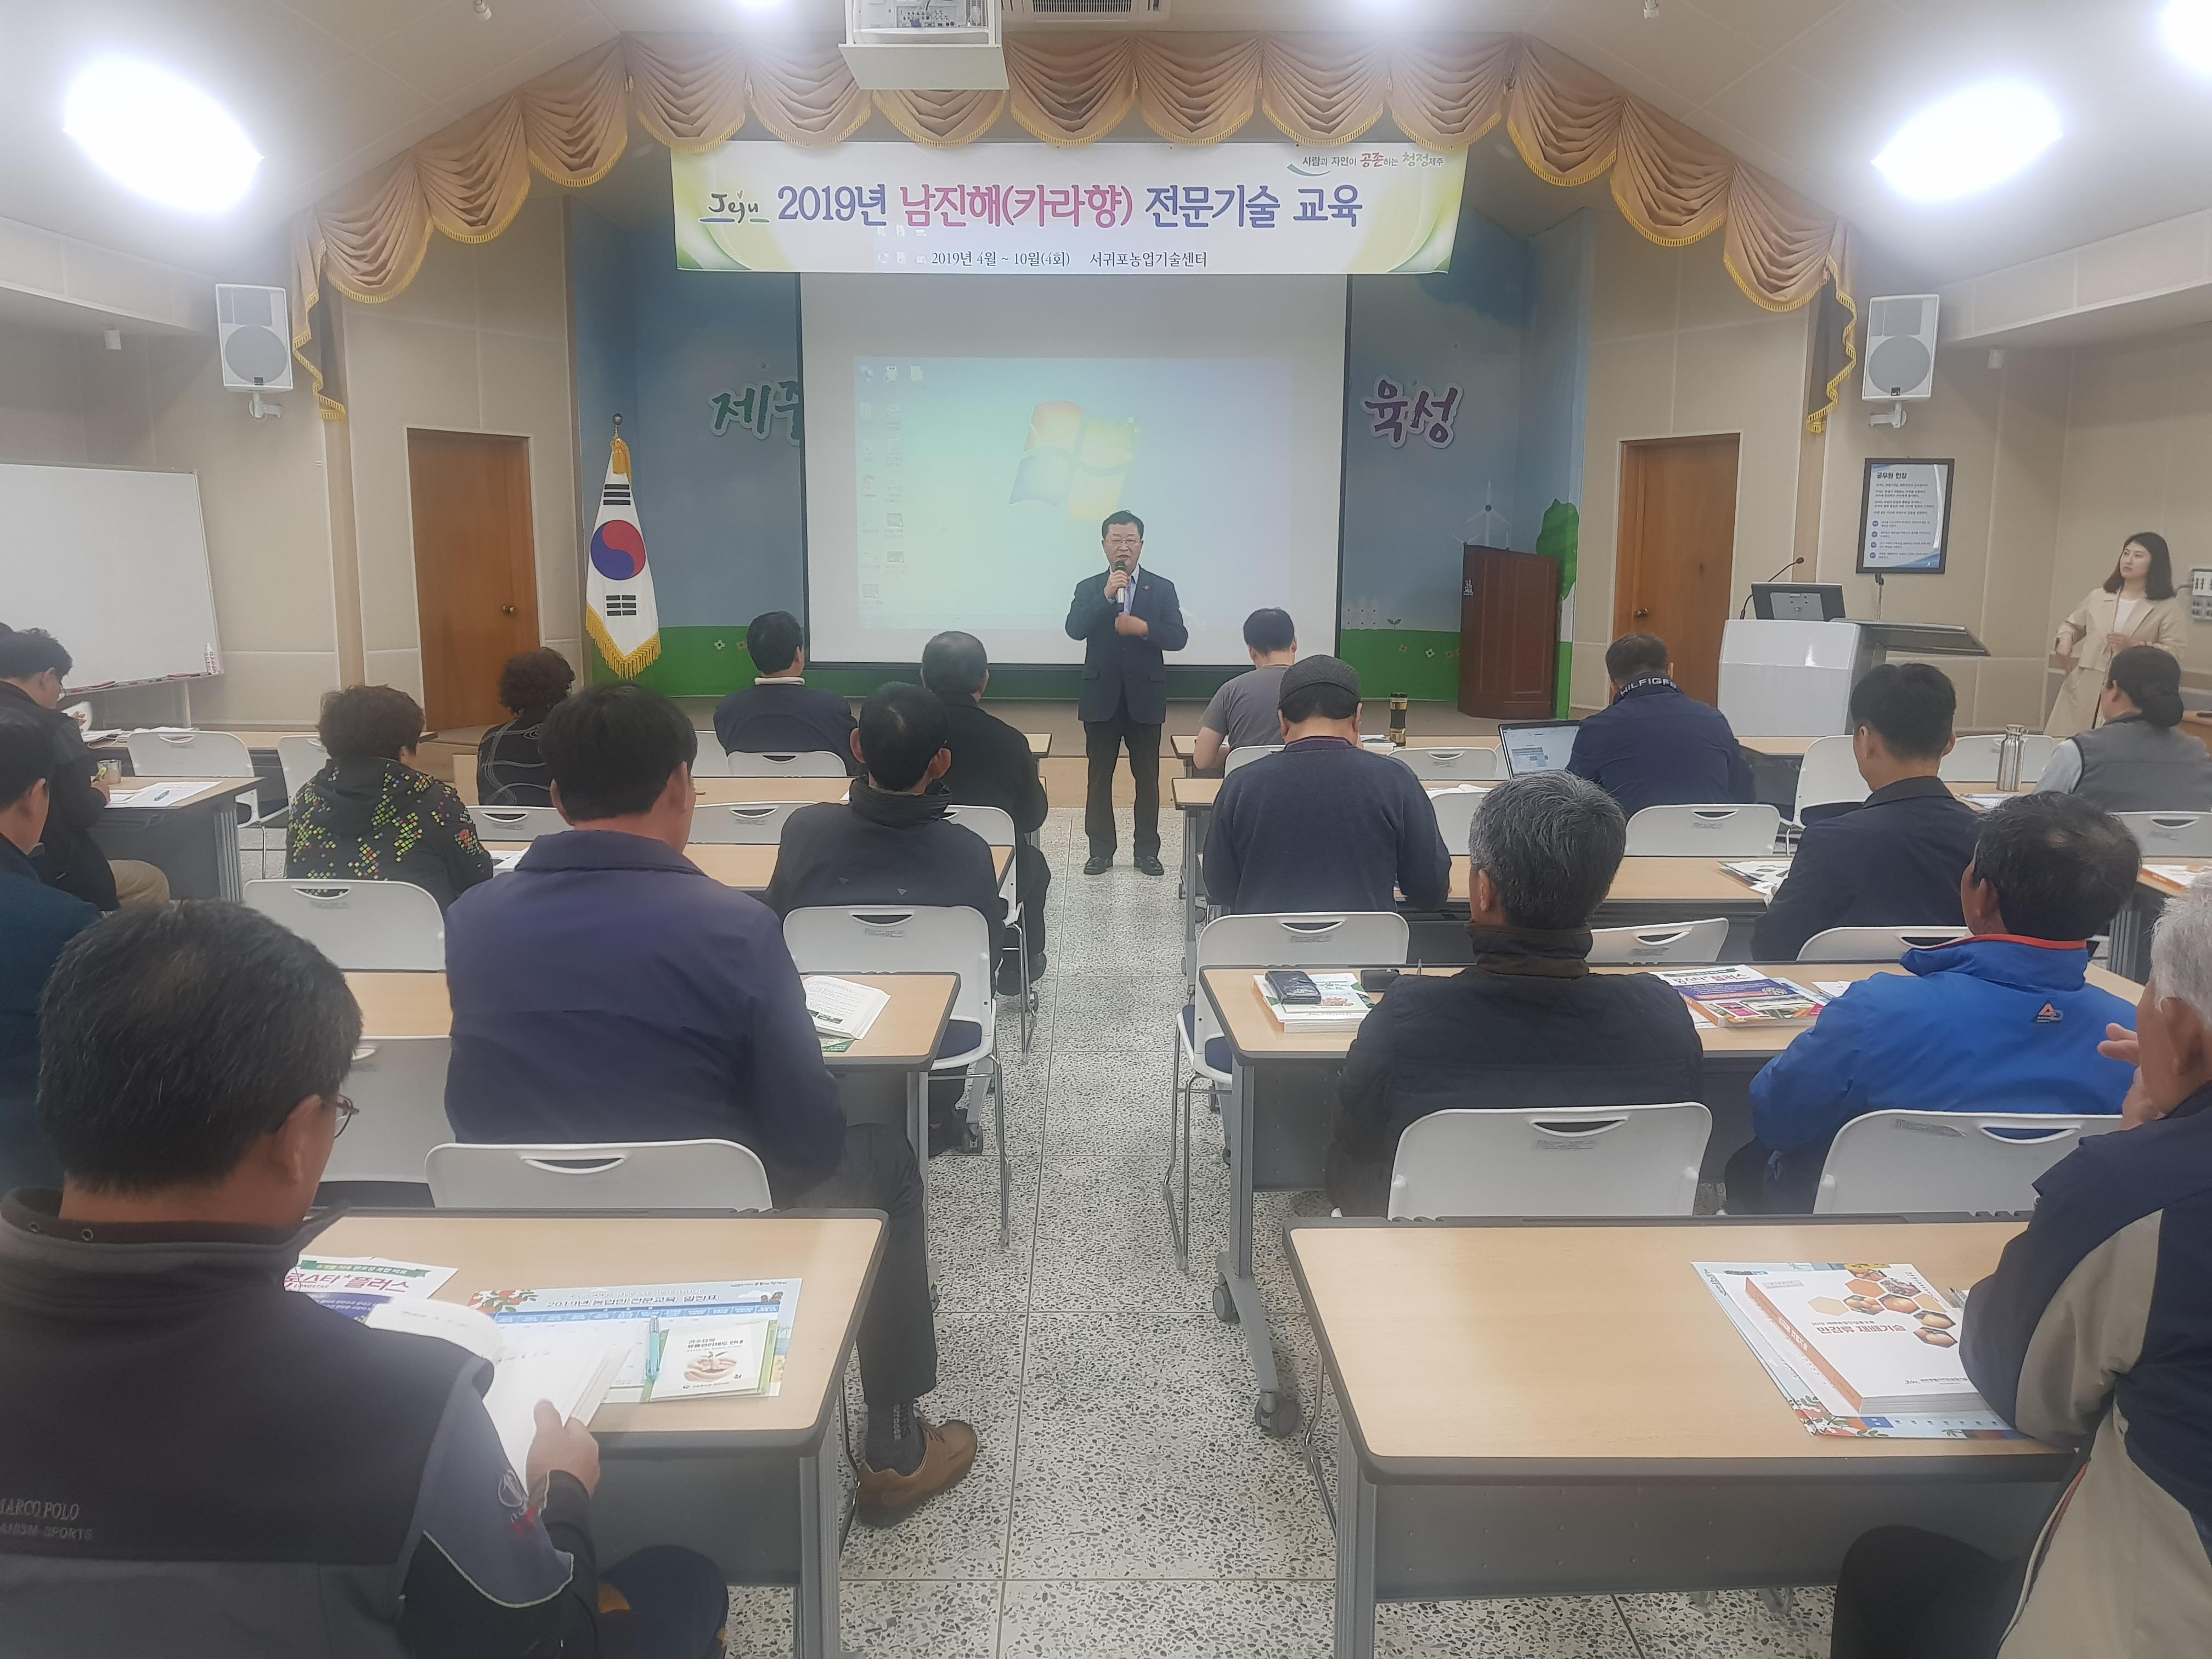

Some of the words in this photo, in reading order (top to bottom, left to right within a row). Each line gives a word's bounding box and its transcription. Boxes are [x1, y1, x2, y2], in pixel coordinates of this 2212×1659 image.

[1302, 156, 1328, 166] 사람과
[1331, 156, 1357, 166] 자연이
[1360, 152, 1399, 168] 공존하는
[708, 192, 759, 224] Jeju
[777, 184, 887, 226] 2019년
[899, 184, 1134, 228] 남진해(카라향)
[1145, 184, 1281, 228] 전문기술
[1292, 184, 1364, 228] 교육
[931, 251, 972, 267] 2019년
[977, 251, 997, 266] 4월
[1014, 251, 1070, 267] 10월(4회)
[1089, 250, 1207, 268] 서귀포농업기술센터
[1364, 379, 1458, 443] 육성
[345, 1276, 409, 1293] 플러스
[42, 1501, 80, 1521] POLO
